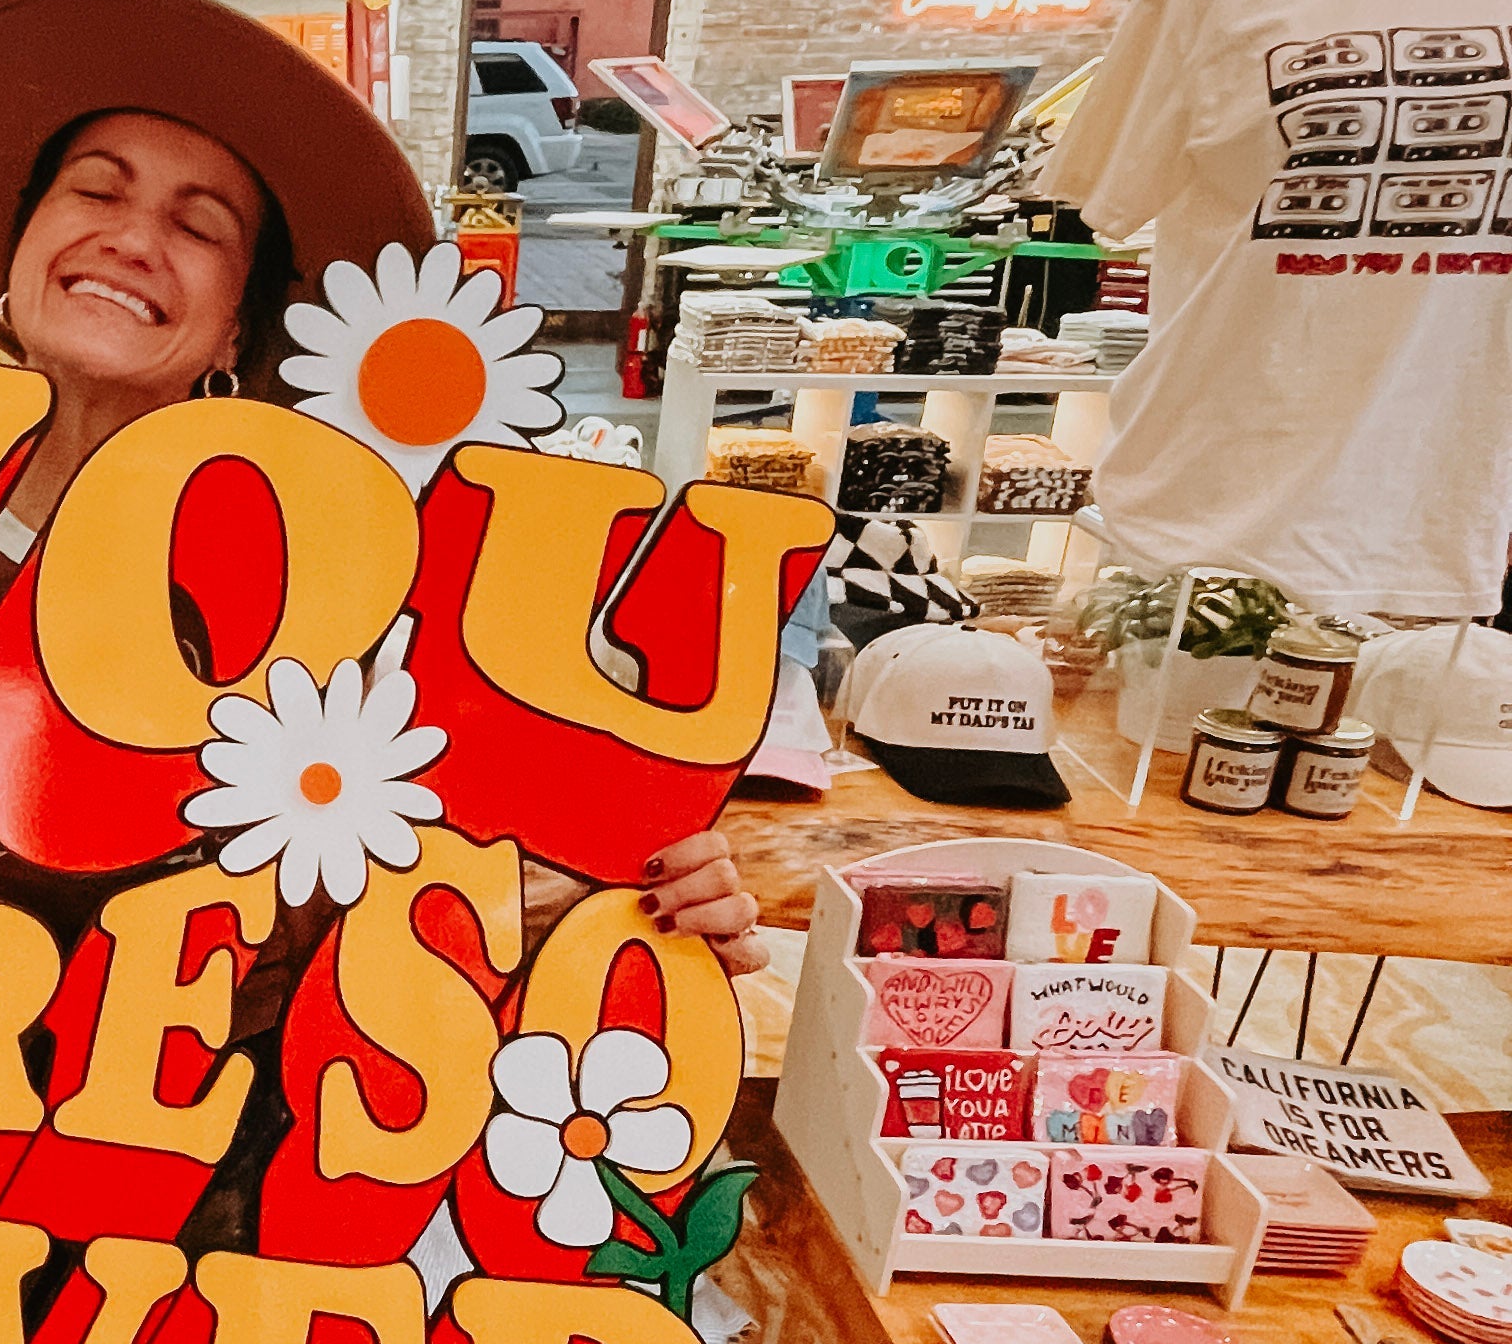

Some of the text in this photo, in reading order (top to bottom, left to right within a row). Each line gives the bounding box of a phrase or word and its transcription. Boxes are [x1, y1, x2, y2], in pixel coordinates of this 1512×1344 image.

[930, 711, 956, 726] MY
[948, 696, 984, 711] PUT
[988, 698, 1005, 712] IT
[315, 824, 746, 1194] SO
[1030, 977, 1150, 1005] WHAT WOULD
[1220, 1056, 1428, 1112] CALIFORNIA
[1278, 1099, 1391, 1143] IS FOR
[1262, 1118, 1455, 1181] DREAMERS
